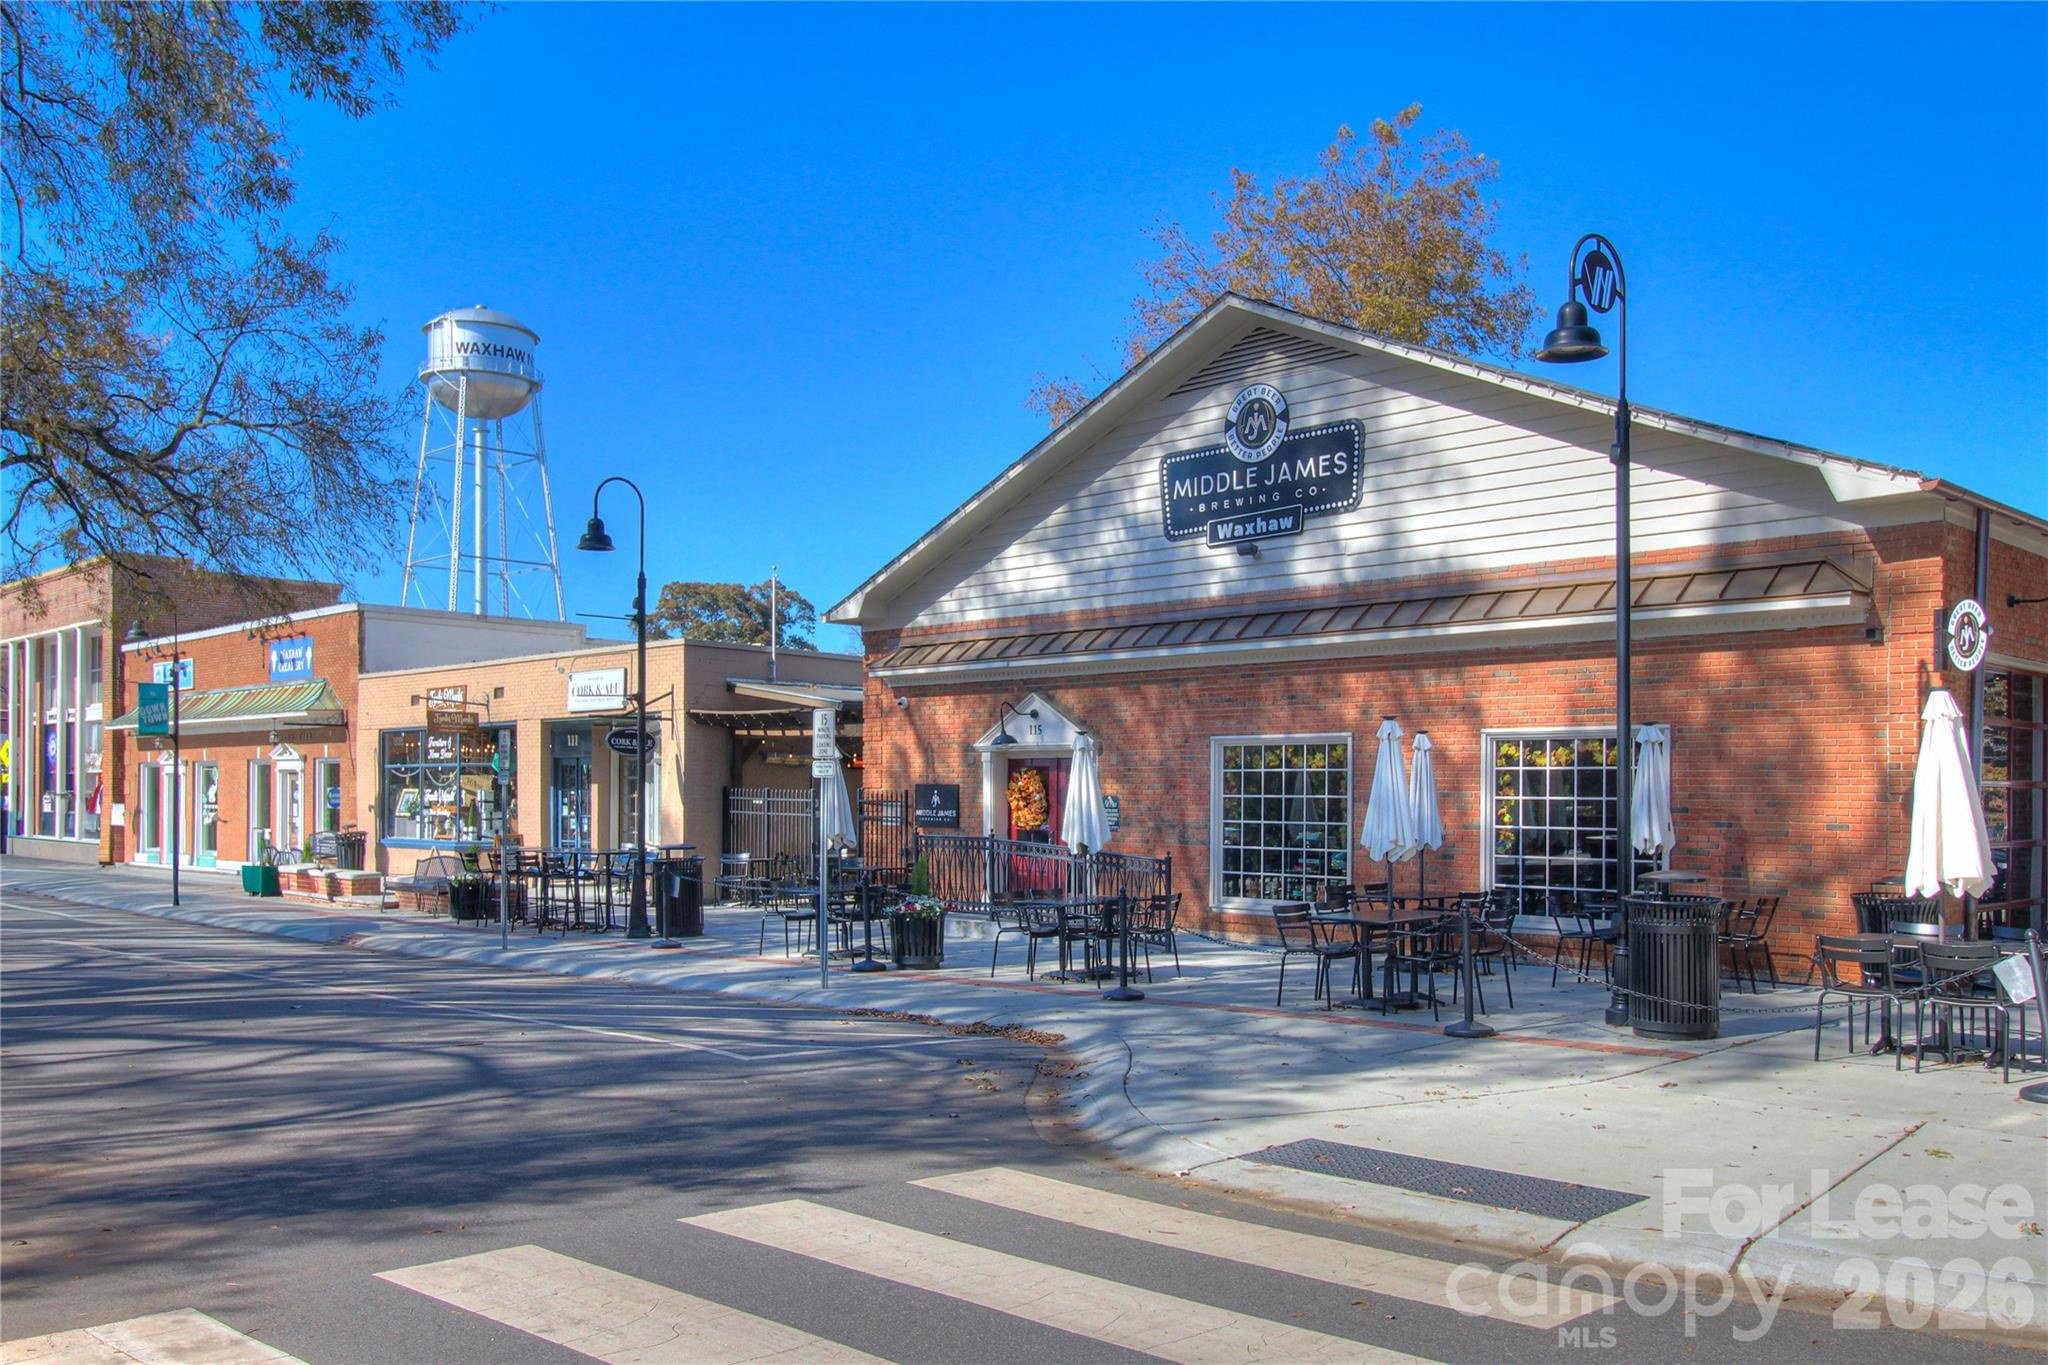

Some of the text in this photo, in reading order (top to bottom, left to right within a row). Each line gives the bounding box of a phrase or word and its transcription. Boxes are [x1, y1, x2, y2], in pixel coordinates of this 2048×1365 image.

[456, 341, 526, 362] WAXHAW
[1232, 387, 1281, 413] GREAT BEER
[1228, 426, 1284, 460] BETTER PEOPLE
[1173, 452, 1348, 500] MIDDLE JAMES
[1198, 492, 1281, 513] BREWING
[1217, 514, 1294, 540] Waxhaw
[572, 684, 593, 697] CORK
[595, 683, 602, 696] &
[143, 710, 168, 724] TOWN
[821, 713, 828, 726] 15
[1029, 724, 1043, 736] 115
[611, 737, 631, 746] CORK
[916, 809, 957, 817] MIDDLE JAMES
